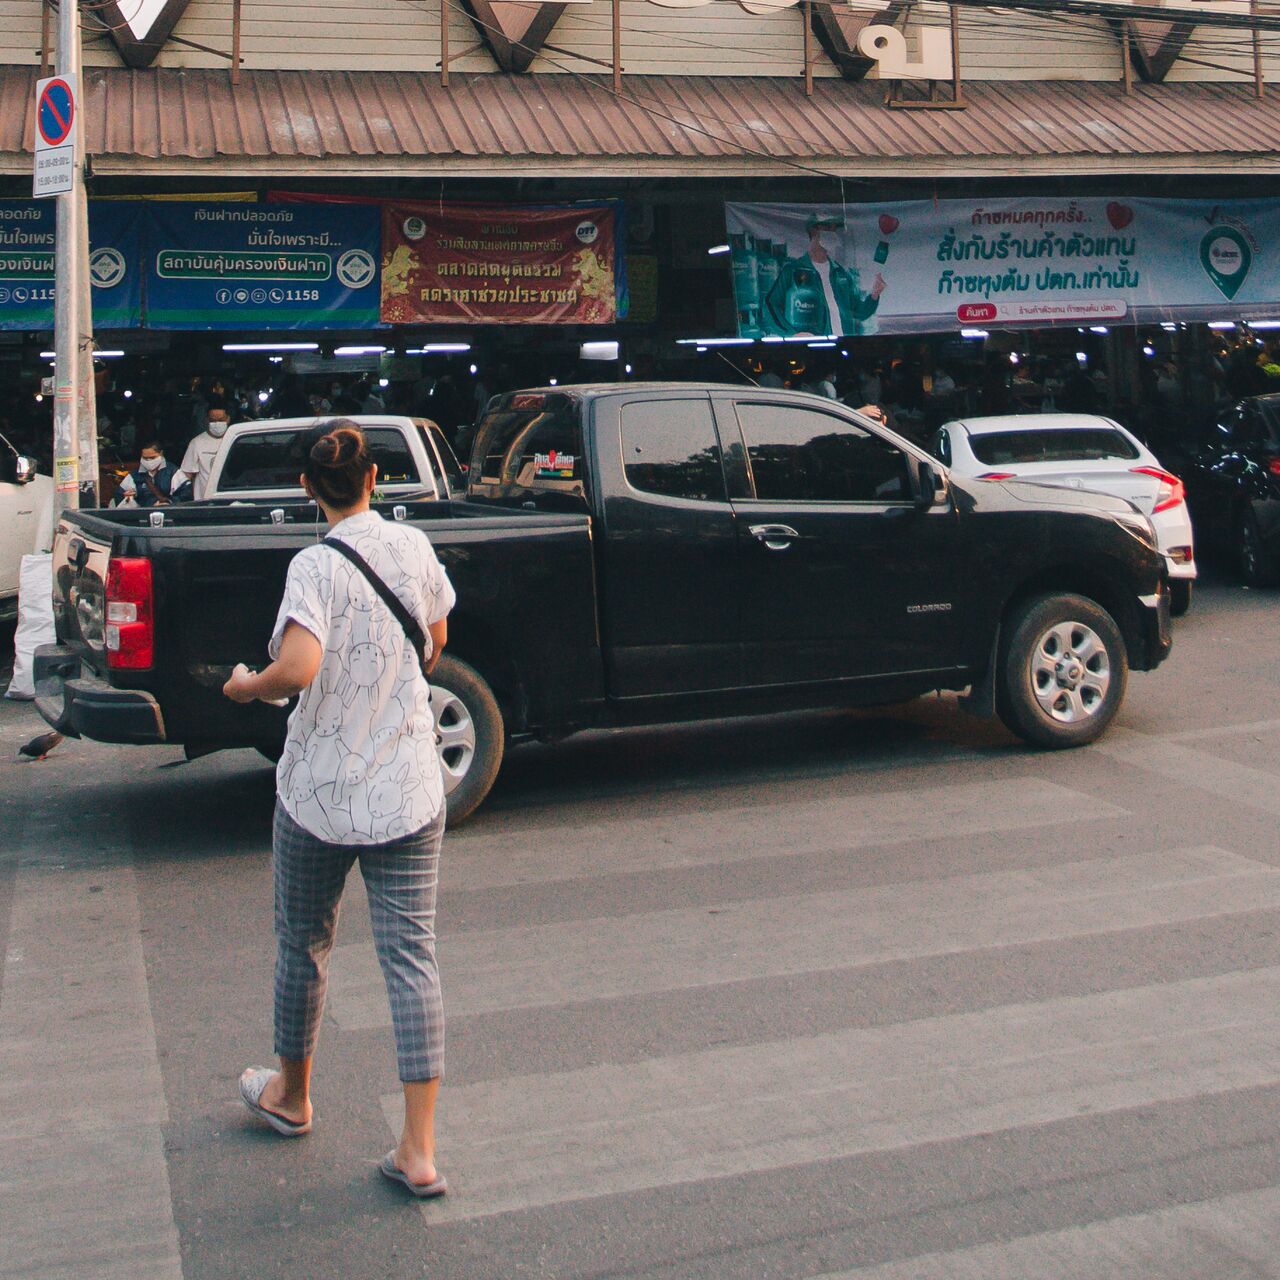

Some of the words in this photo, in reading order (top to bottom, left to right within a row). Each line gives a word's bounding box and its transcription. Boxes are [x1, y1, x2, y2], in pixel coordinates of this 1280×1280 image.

[194, 208, 294, 223] เงินฝากปลอดภัย
[936, 227, 1137, 262] สั่งกับร้านค้าตัวแทน
[163, 254, 327, 275] สถาบันคุ้มครองเงินฝาก
[937, 268, 1030, 300] ก๊าซหุงต้ม
[1036, 260, 1140, 291] ปตท.เท่านั้น
[285, 289, 320, 302] 1158
[420, 281, 578, 304] ลดราคาช่วยประชาชน
